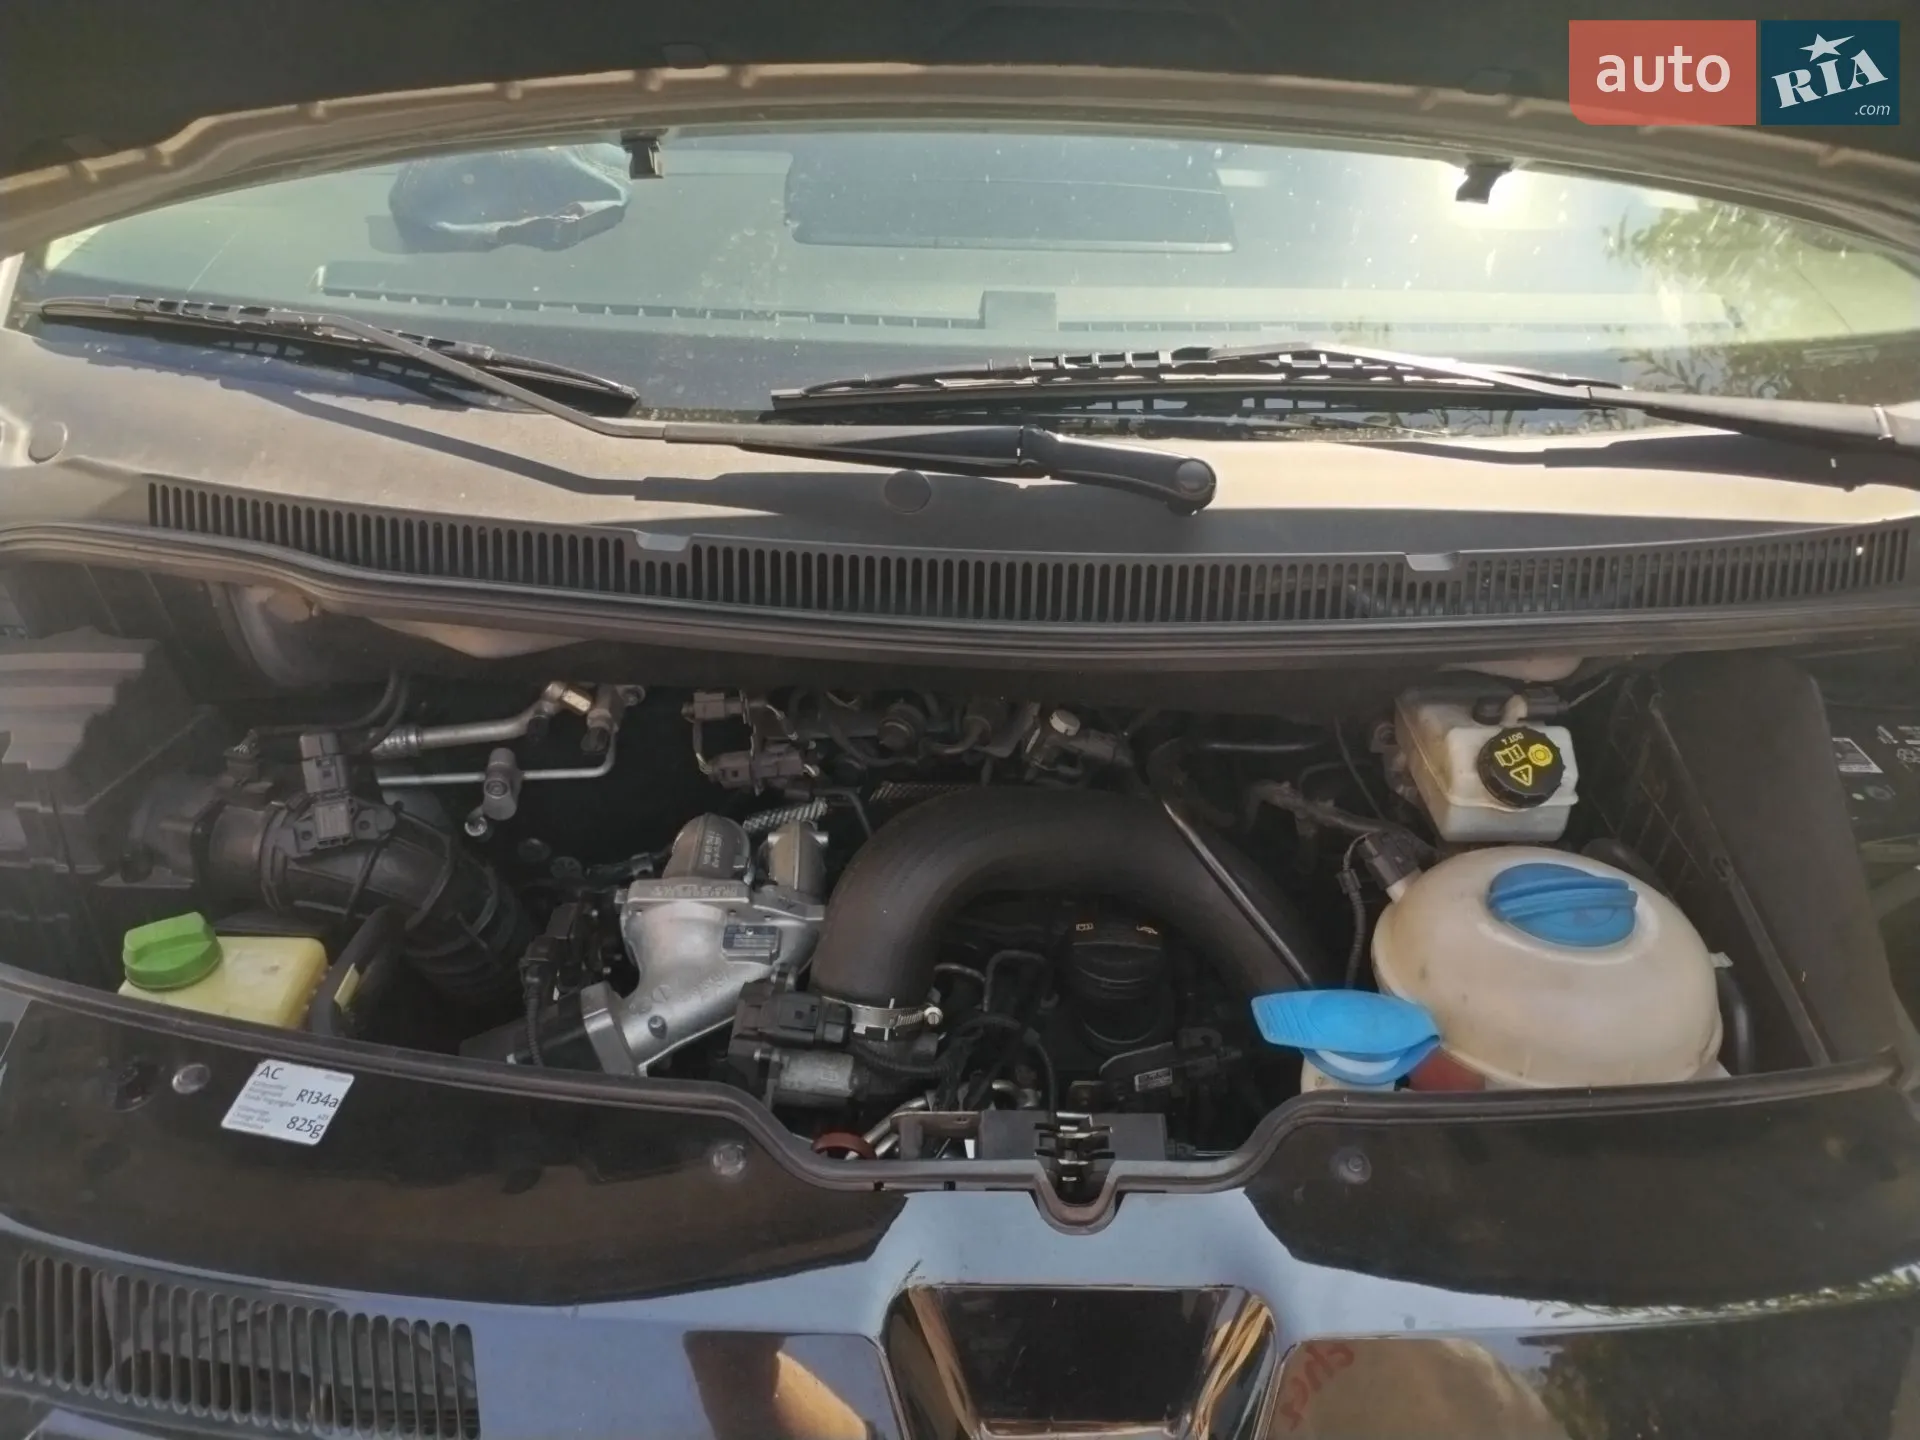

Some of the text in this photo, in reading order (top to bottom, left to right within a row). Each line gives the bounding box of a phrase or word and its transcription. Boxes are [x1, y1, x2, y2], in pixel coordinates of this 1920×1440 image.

[257, 1065, 284, 1080] AC
[296, 1088, 339, 1108] R134a
[286, 1115, 325, 1139] 825g
